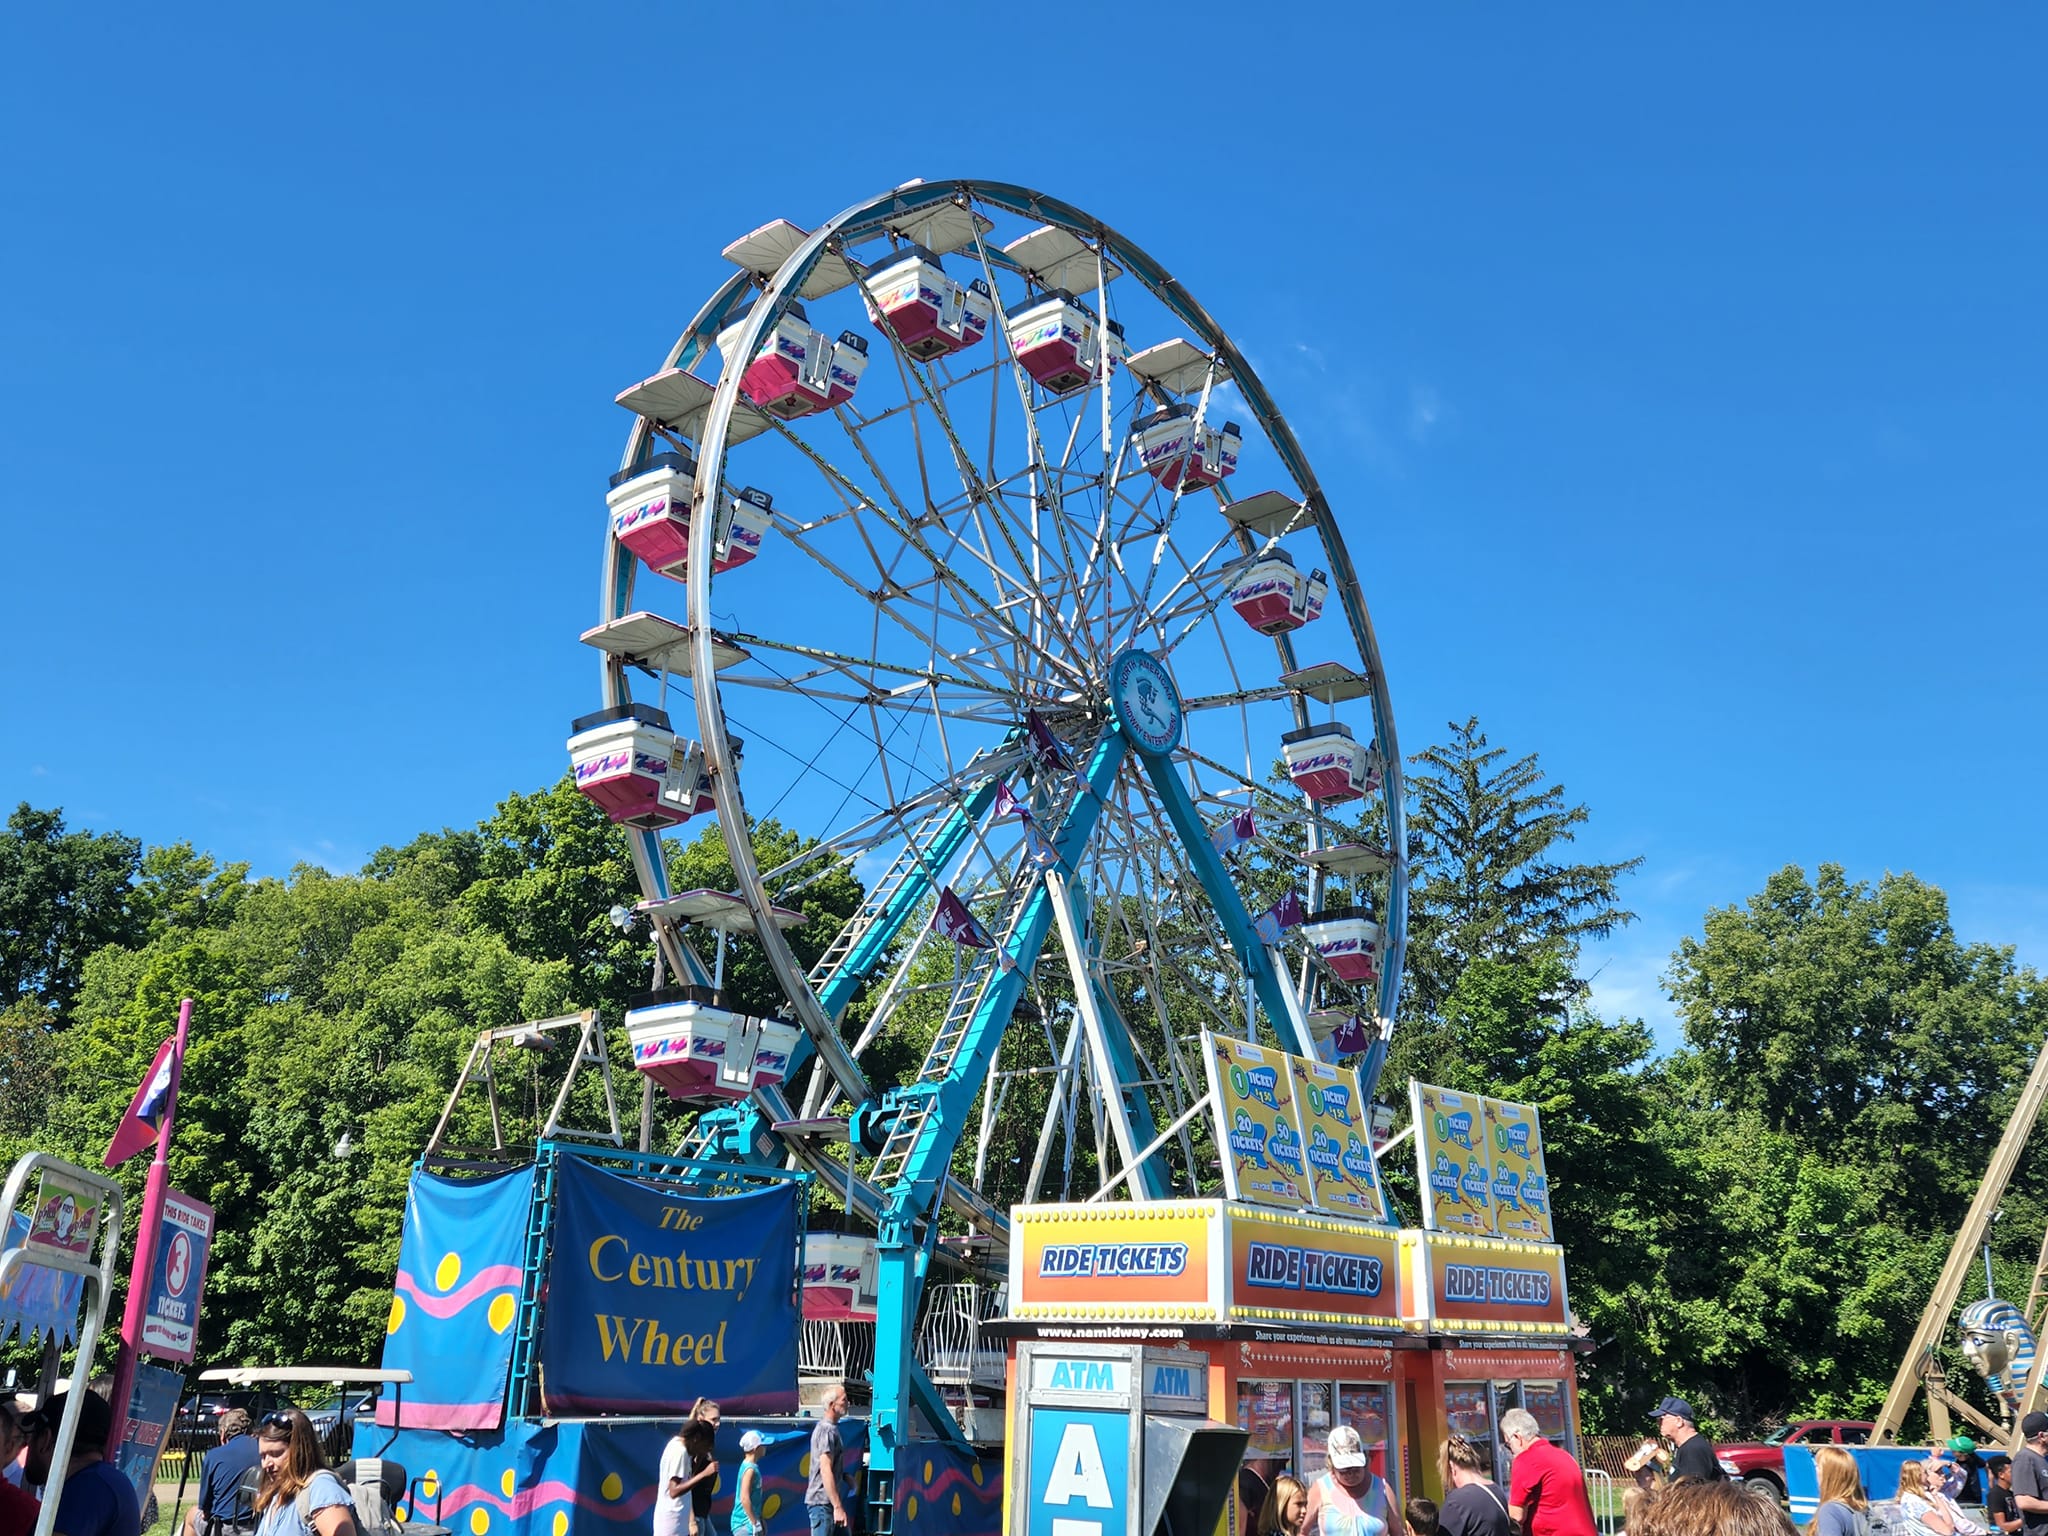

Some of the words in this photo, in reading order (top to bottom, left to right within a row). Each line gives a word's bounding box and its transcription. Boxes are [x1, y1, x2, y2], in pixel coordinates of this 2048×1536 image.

[976, 280, 988, 294] 10
[844, 333, 858, 347] 11
[748, 490, 767, 508] 12
[1314, 569, 1321, 579] 7
[1121, 658, 1137, 689] NORTH
[1138, 658, 1173, 700] AMERICAN
[1122, 700, 1144, 735] MIDWAY
[1248, 1071, 1274, 1090] TICKET
[1322, 1089, 1347, 1106] TICKET
[1235, 1114, 1252, 1132] 20
[1447, 1117, 1469, 1131] TICKET
[1276, 1123, 1289, 1142] 50
[1313, 1131, 1328, 1148] 20
[1507, 1128, 1527, 1141] TICKET
[1231, 1134, 1265, 1154] TICKETS
[1271, 1141, 1301, 1160] TICKETS
[1349, 1138, 1361, 1155] 50
[1309, 1148, 1339, 1167] TICKETS
[1345, 1156, 1372, 1173] TICKETS
[1437, 1156, 1449, 1172] 20
[1469, 1161, 1479, 1176] 50
[1497, 1166, 1509, 1180] 20
[1527, 1170, 1537, 1185] 50
[1431, 1173, 1458, 1189] TICKETS
[1463, 1178, 1487, 1193] TICKETS
[1493, 1182, 1517, 1197] TICKETS
[1522, 1187, 1545, 1200] TICKETS
[164, 1203, 178, 1219] THIS
[178, 1209, 190, 1225] RIDE
[191, 1215, 206, 1232] TAKES
[658, 1206, 703, 1231] The
[169, 1236, 188, 1291] 3
[589, 1234, 760, 1302] Century
[1042, 1247, 1093, 1273] RIDE
[1098, 1246, 1184, 1273] TICKETS
[1250, 1245, 1300, 1283] RIDE
[1304, 1252, 1380, 1292] TICKETS
[1446, 1267, 1485, 1298] RIDE
[1489, 1270, 1549, 1303] TICKETS
[157, 1296, 187, 1321] TICKETS
[594, 1313, 727, 1366] Wheel
[1037, 1327, 1184, 1339] www.namidway.com
[1256, 1330, 1272, 1341] Share
[1273, 1333, 1286, 1342] your
[1287, 1332, 1315, 1344] experience
[1317, 1335, 1328, 1344] with
[1344, 1337, 1394, 1348] www.namidway.com
[1050, 1361, 1114, 1391] ATM
[1153, 1366, 1191, 1396] ATM
[1043, 1422, 1114, 1536] A
